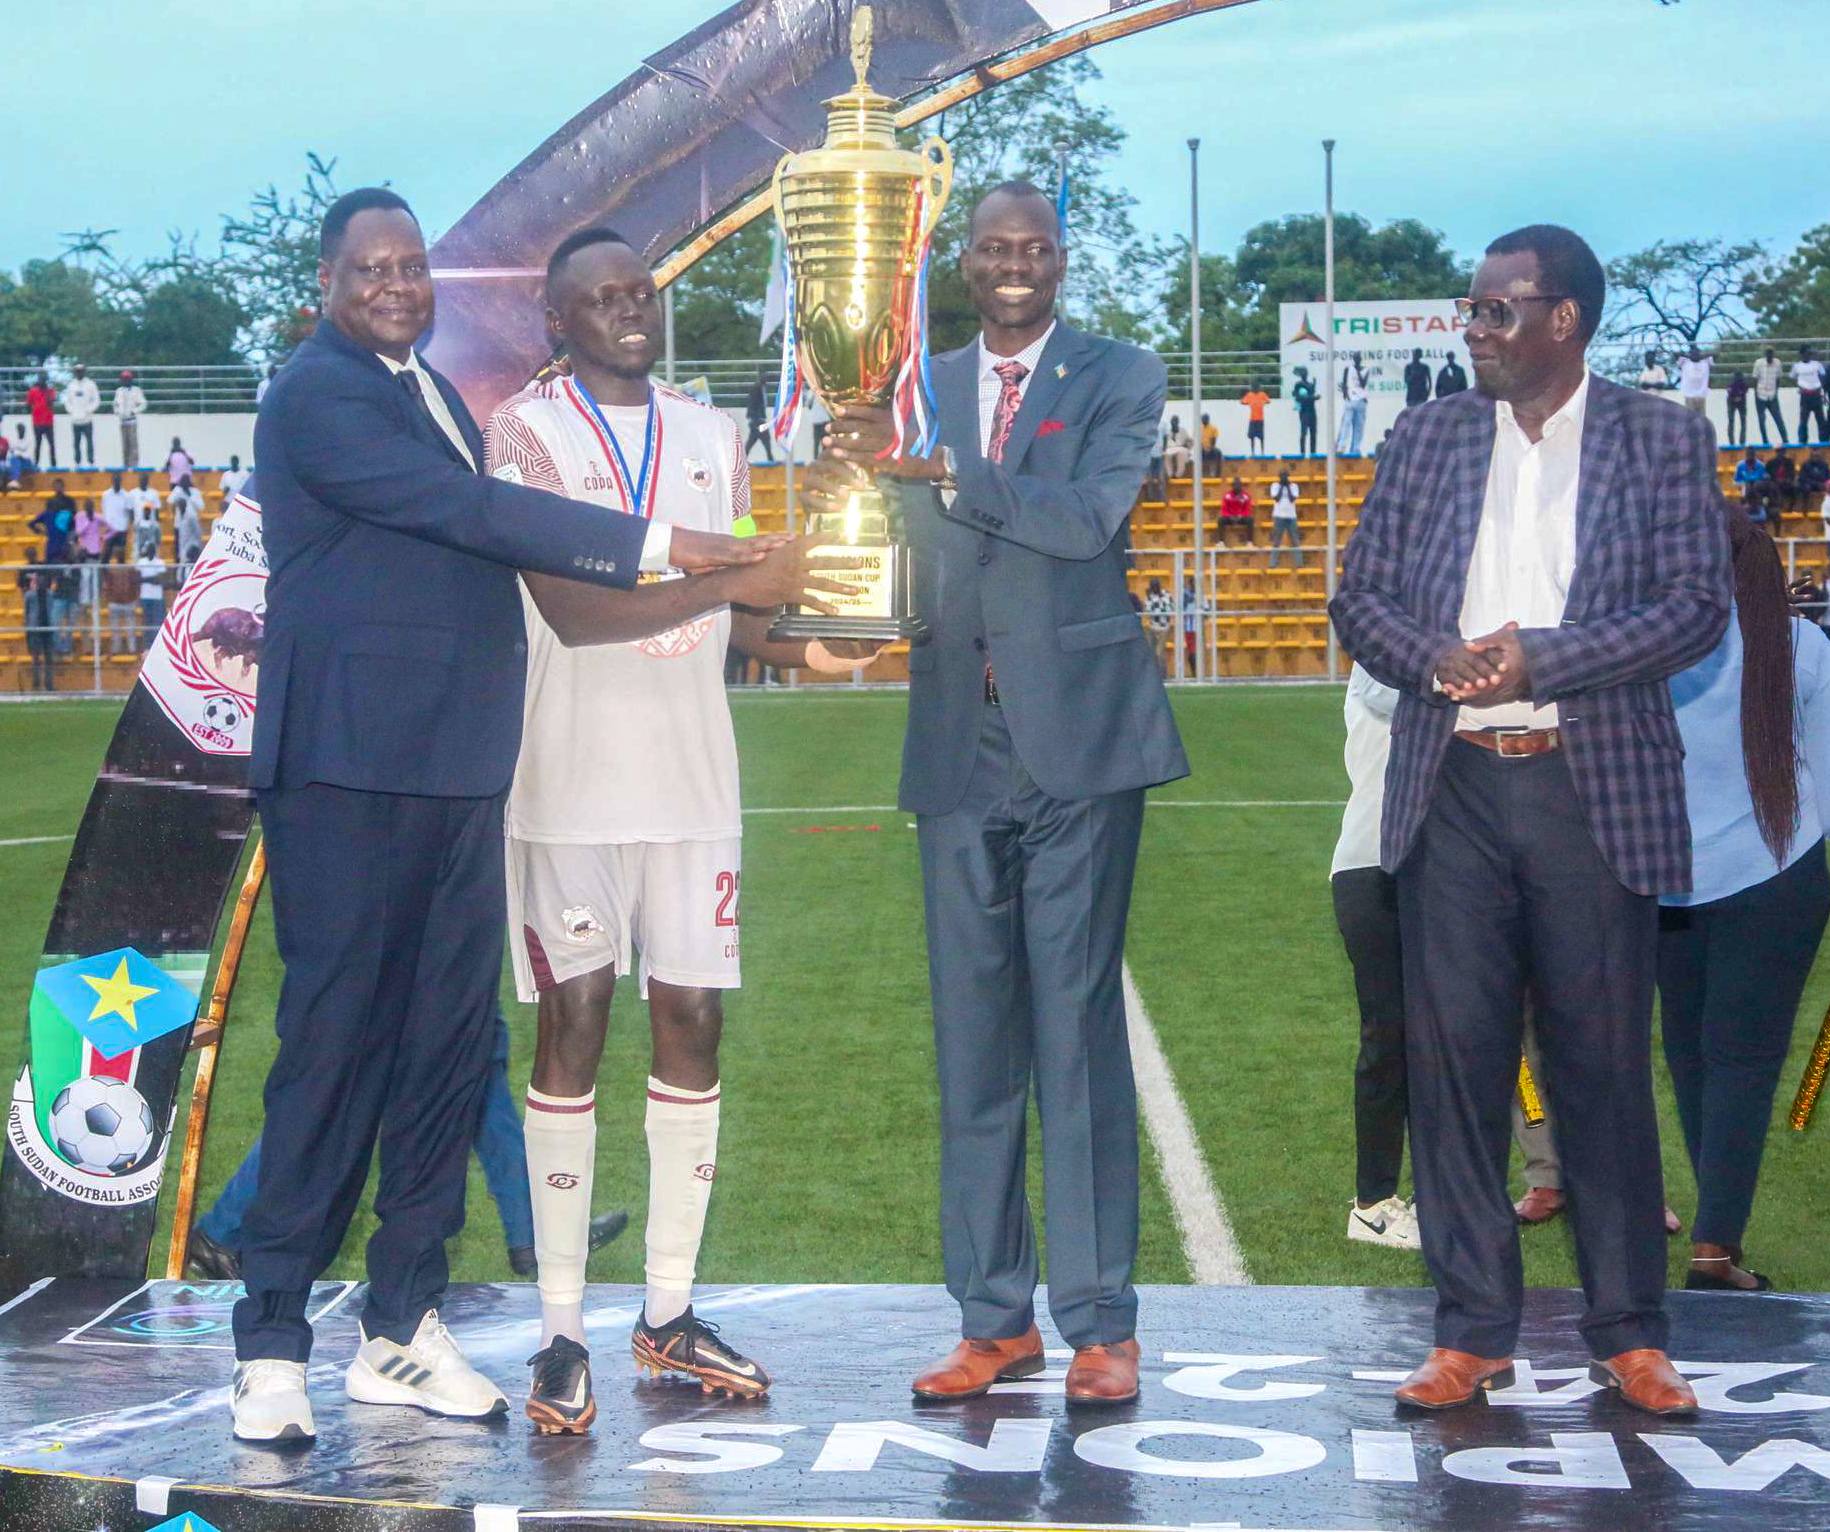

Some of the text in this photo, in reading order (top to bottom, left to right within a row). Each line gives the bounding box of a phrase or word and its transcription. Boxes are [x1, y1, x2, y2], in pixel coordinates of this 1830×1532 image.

[1309, 348, 1446, 361] SUPORING FOOALL
[225, 541, 256, 563] Juba
[9, 1105, 27, 1147] SOUTH
[22, 1146, 59, 1182] SUDAN
[57, 1177, 125, 1201] FOOTBALL
